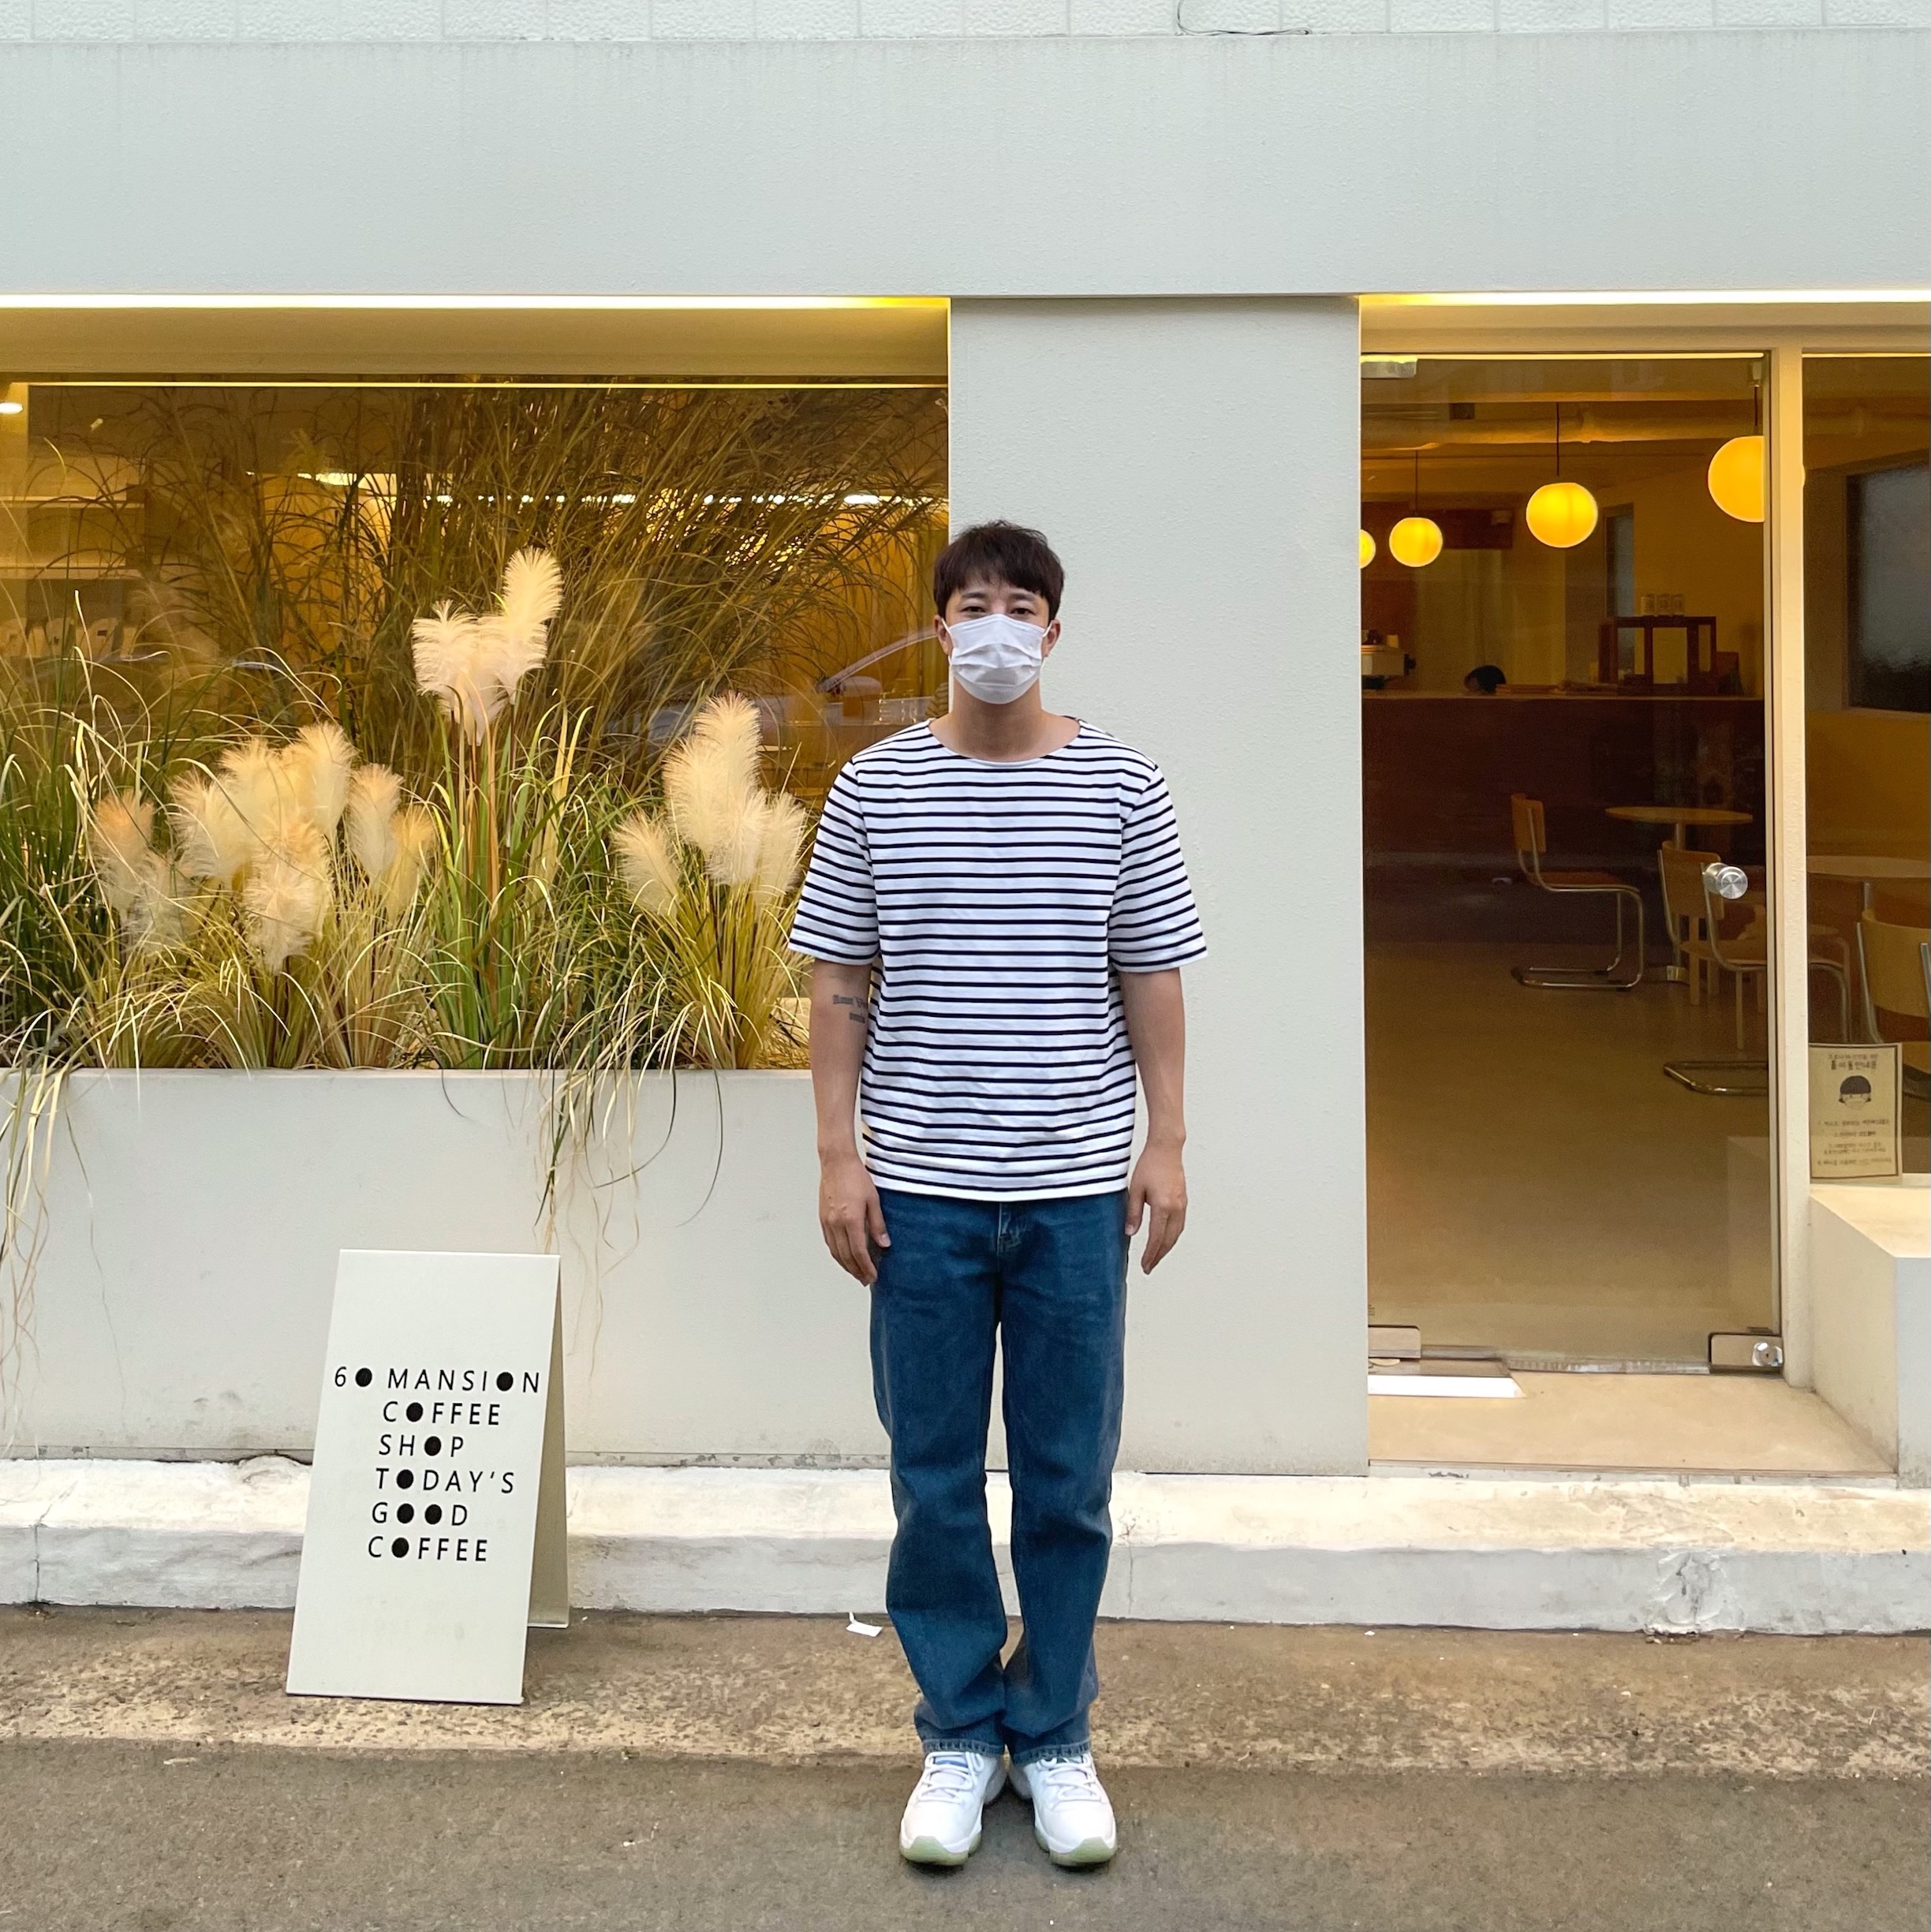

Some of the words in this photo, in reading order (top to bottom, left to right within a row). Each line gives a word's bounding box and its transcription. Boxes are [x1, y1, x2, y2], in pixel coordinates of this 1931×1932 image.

[387, 1368, 540, 1393] MANSION
[383, 1400, 500, 1426] COFFEE
[379, 1433, 464, 1458] SHOP
[375, 1467, 514, 1494] TODAY'S
[372, 1501, 468, 1527] GOOD
[368, 1535, 487, 1562] COFFEE
